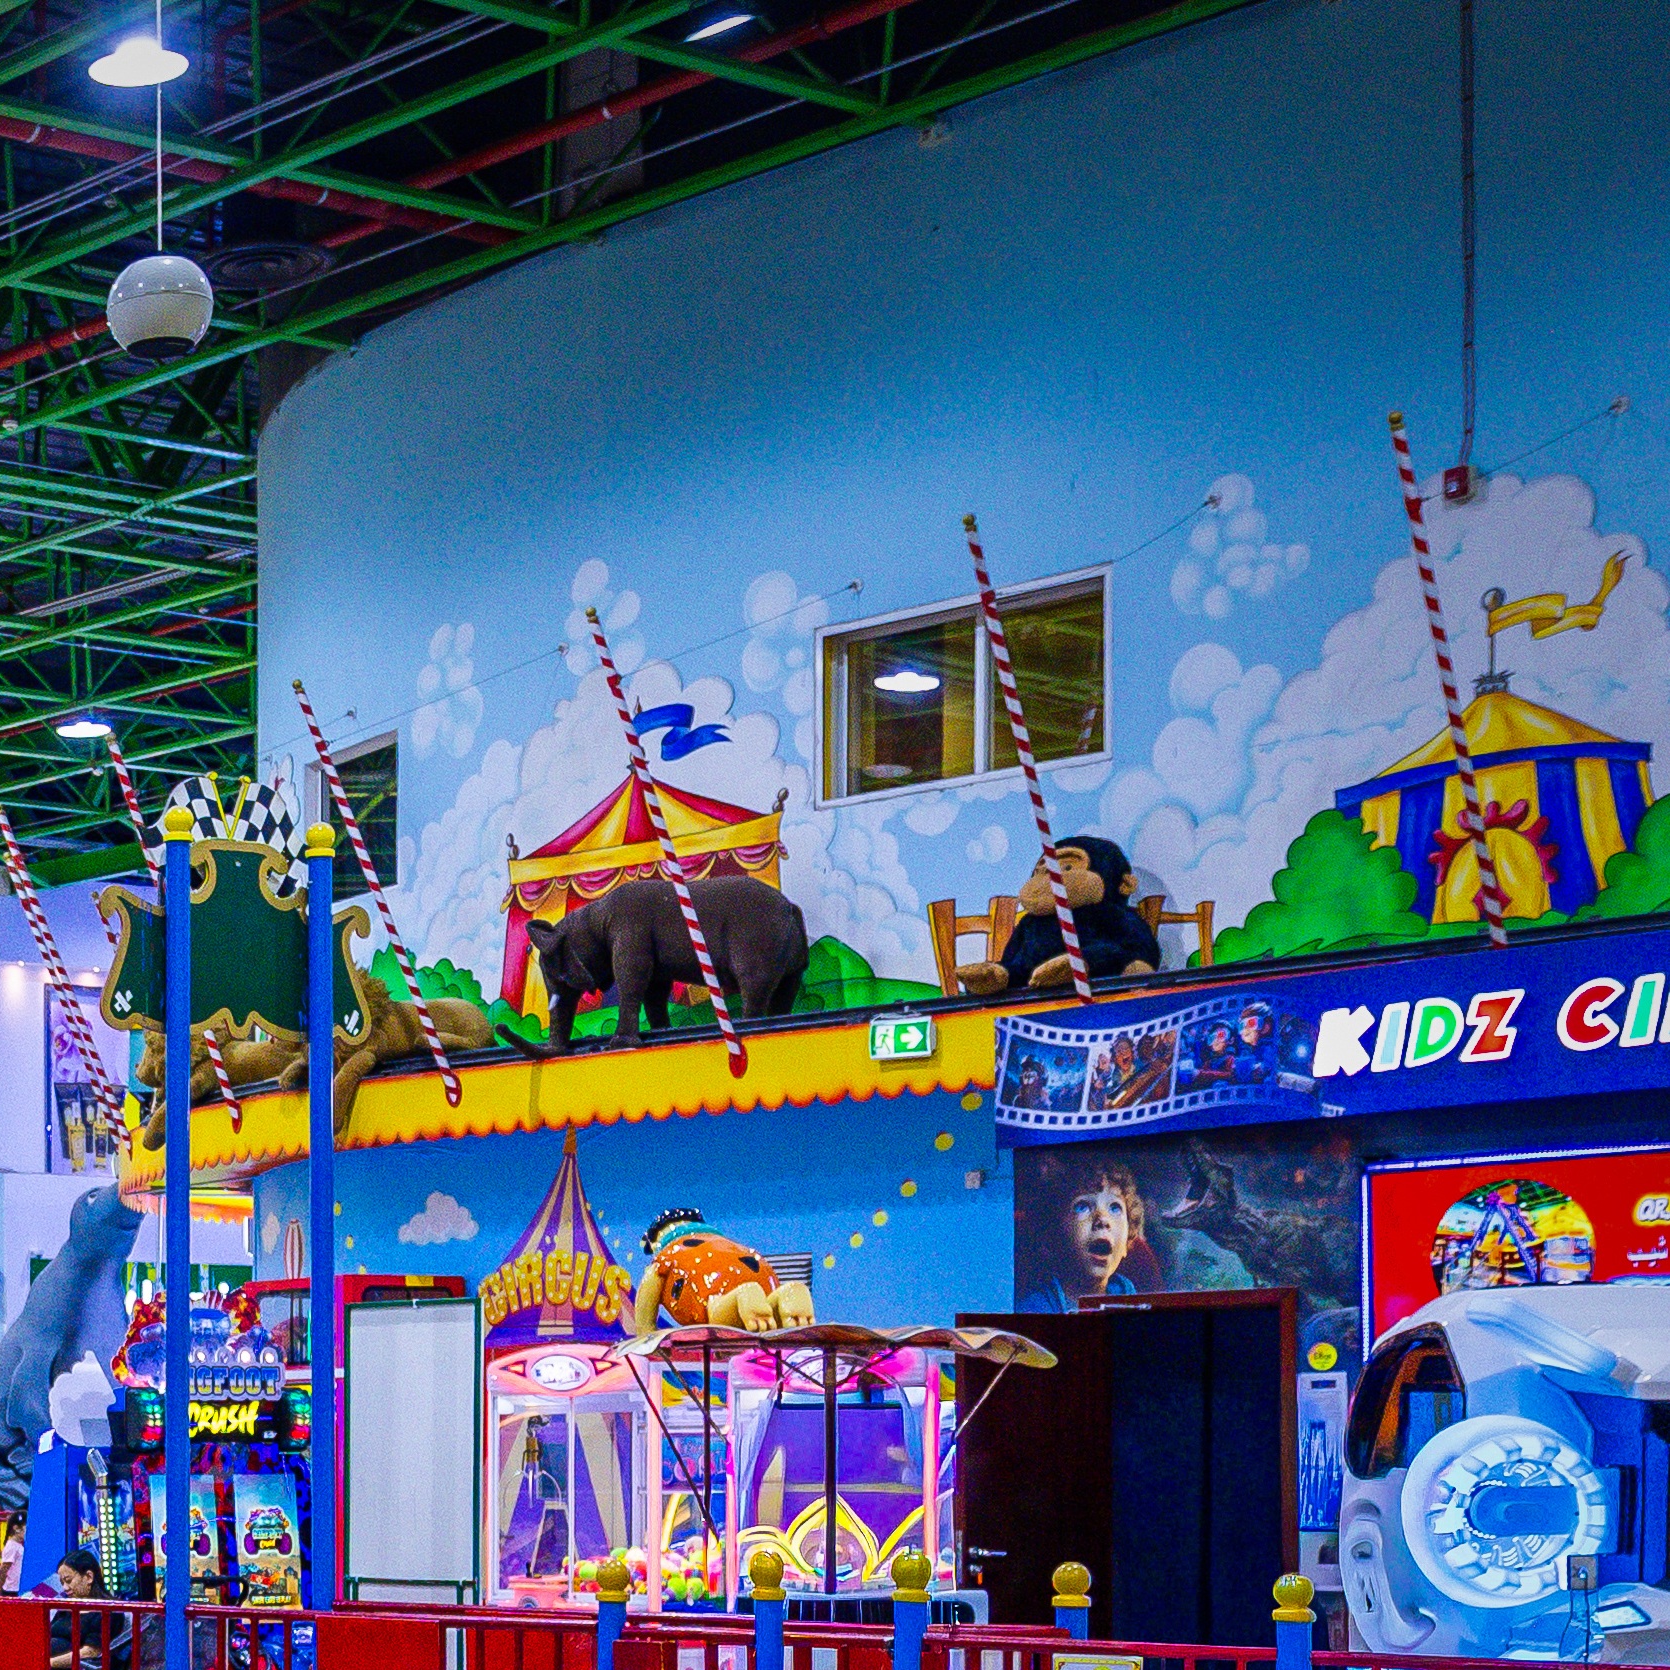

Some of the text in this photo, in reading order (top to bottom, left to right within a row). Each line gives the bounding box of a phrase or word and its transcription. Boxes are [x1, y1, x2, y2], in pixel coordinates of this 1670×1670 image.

[1312, 972, 1670, 1078] KIDZ CI
[478, 1250, 632, 1325] CIRCUS
[189, 1365, 281, 1396] IGFOOT
[189, 1400, 260, 1438] CRUSH
